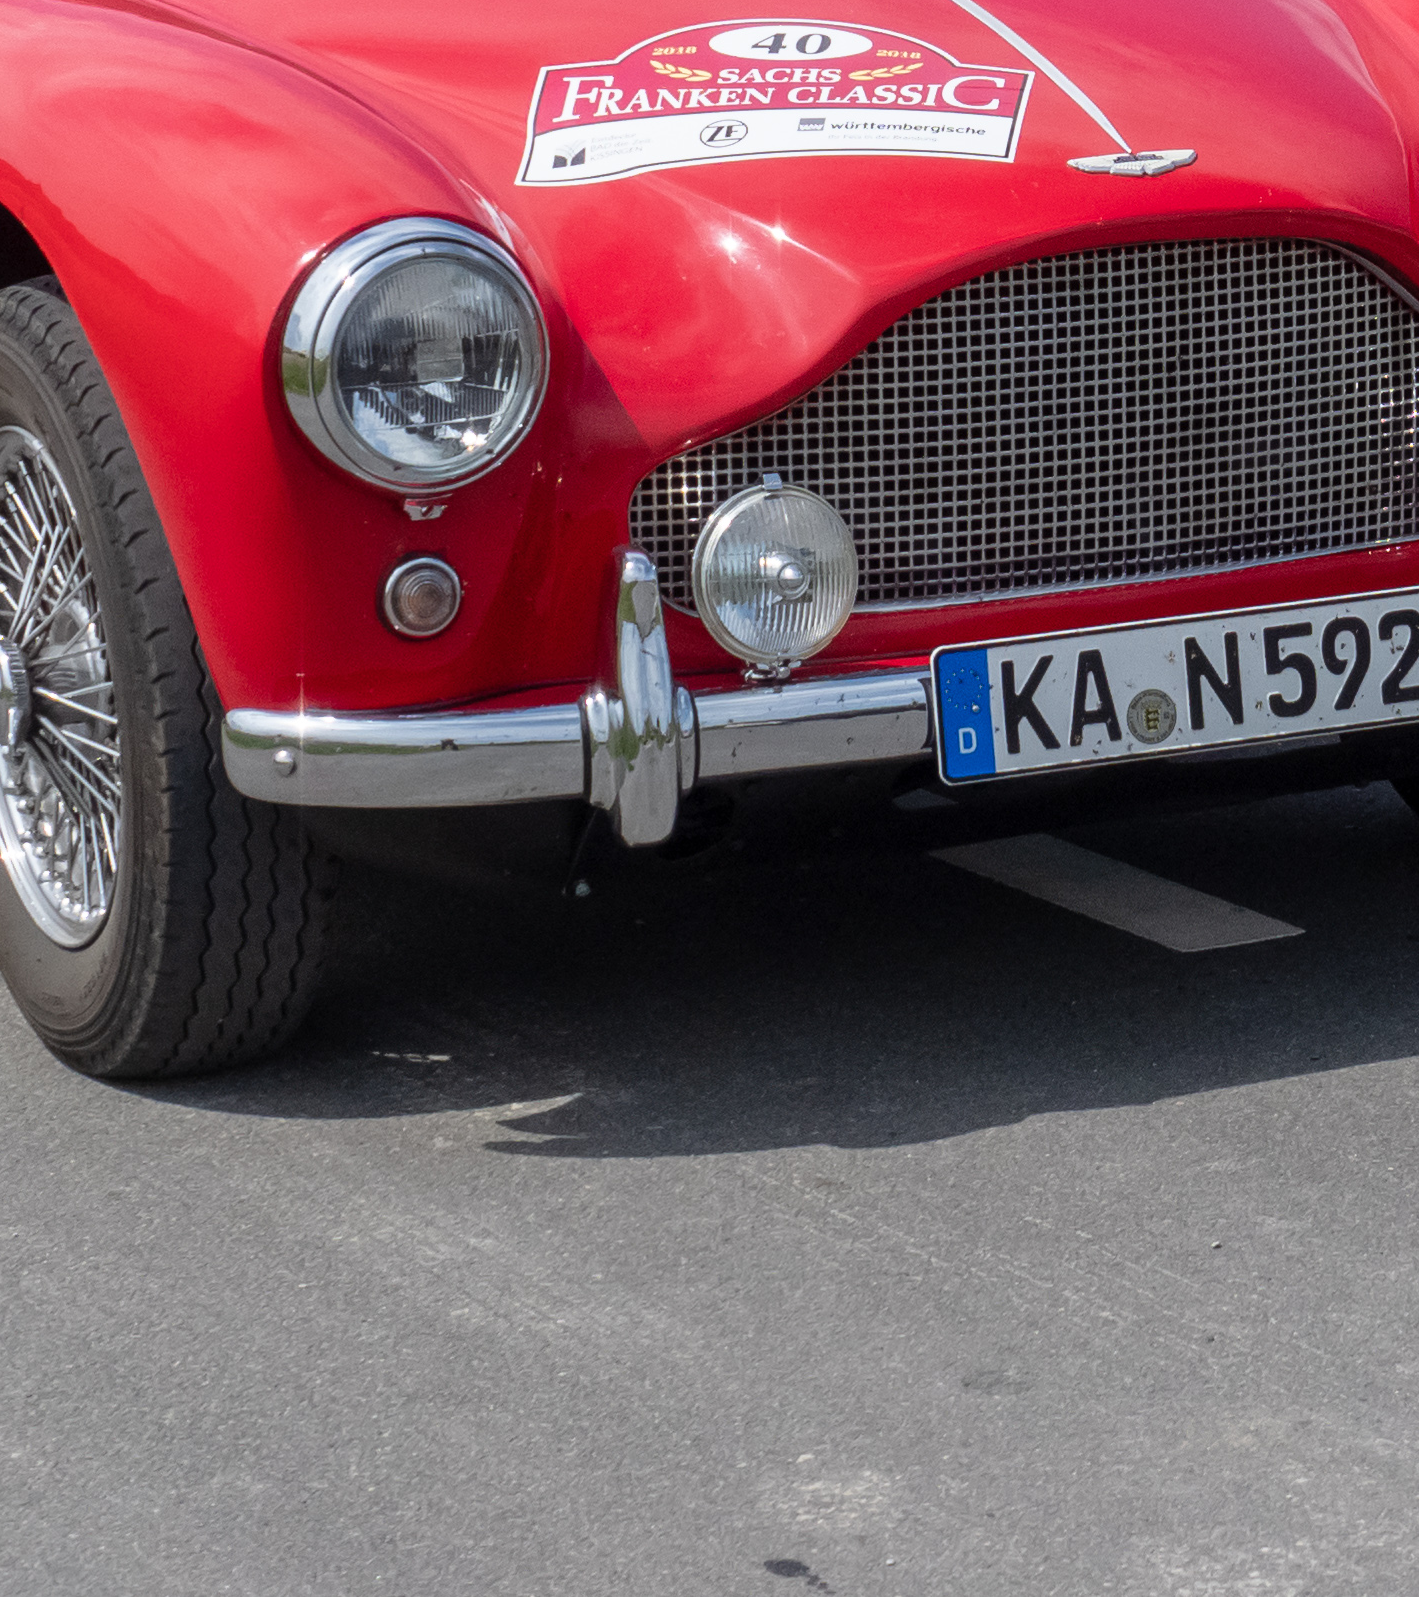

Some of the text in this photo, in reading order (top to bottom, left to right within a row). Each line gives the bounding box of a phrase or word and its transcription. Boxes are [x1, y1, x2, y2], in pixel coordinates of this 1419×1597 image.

[652, 46, 697, 56] 2018
[750, 32, 832, 54] 40
[876, 49, 922, 59] 2018
[716, 68, 842, 84] SACHS
[552, 75, 1007, 123] FRANKEN CLASSIC
[830, 121, 987, 136] württembergische
[999, 649, 1123, 755] KA
[958, 728, 978, 754] D
